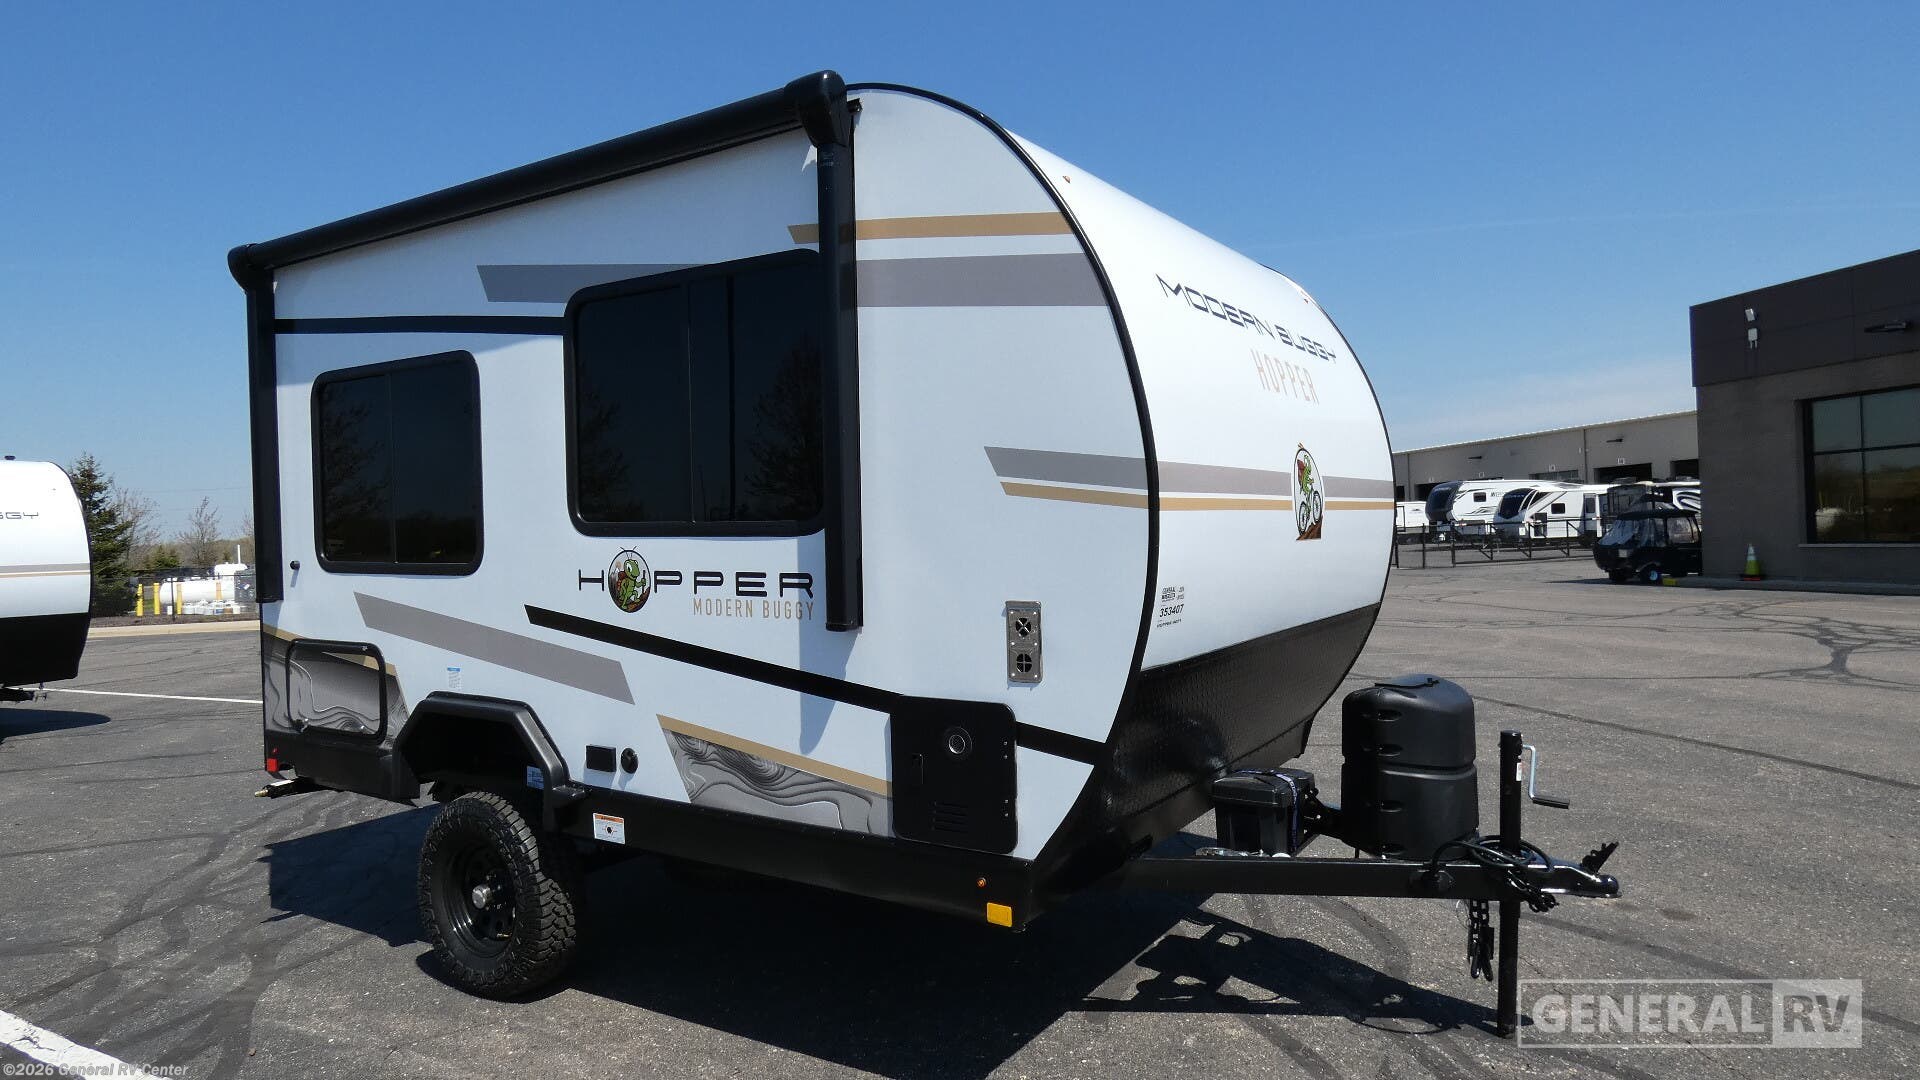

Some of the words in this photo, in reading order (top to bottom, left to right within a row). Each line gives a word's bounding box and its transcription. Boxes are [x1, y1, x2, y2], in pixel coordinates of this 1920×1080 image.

[1155, 273, 1276, 340] MODERN
[1273, 324, 1337, 364] BUGGY
[1250, 347, 1320, 406] HOPPER
[0, 511, 39, 520] GY
[693, 598, 753, 618] MODERN
[762, 601, 814, 621] BUGGY
[1159, 603, 1185, 618] 353407
